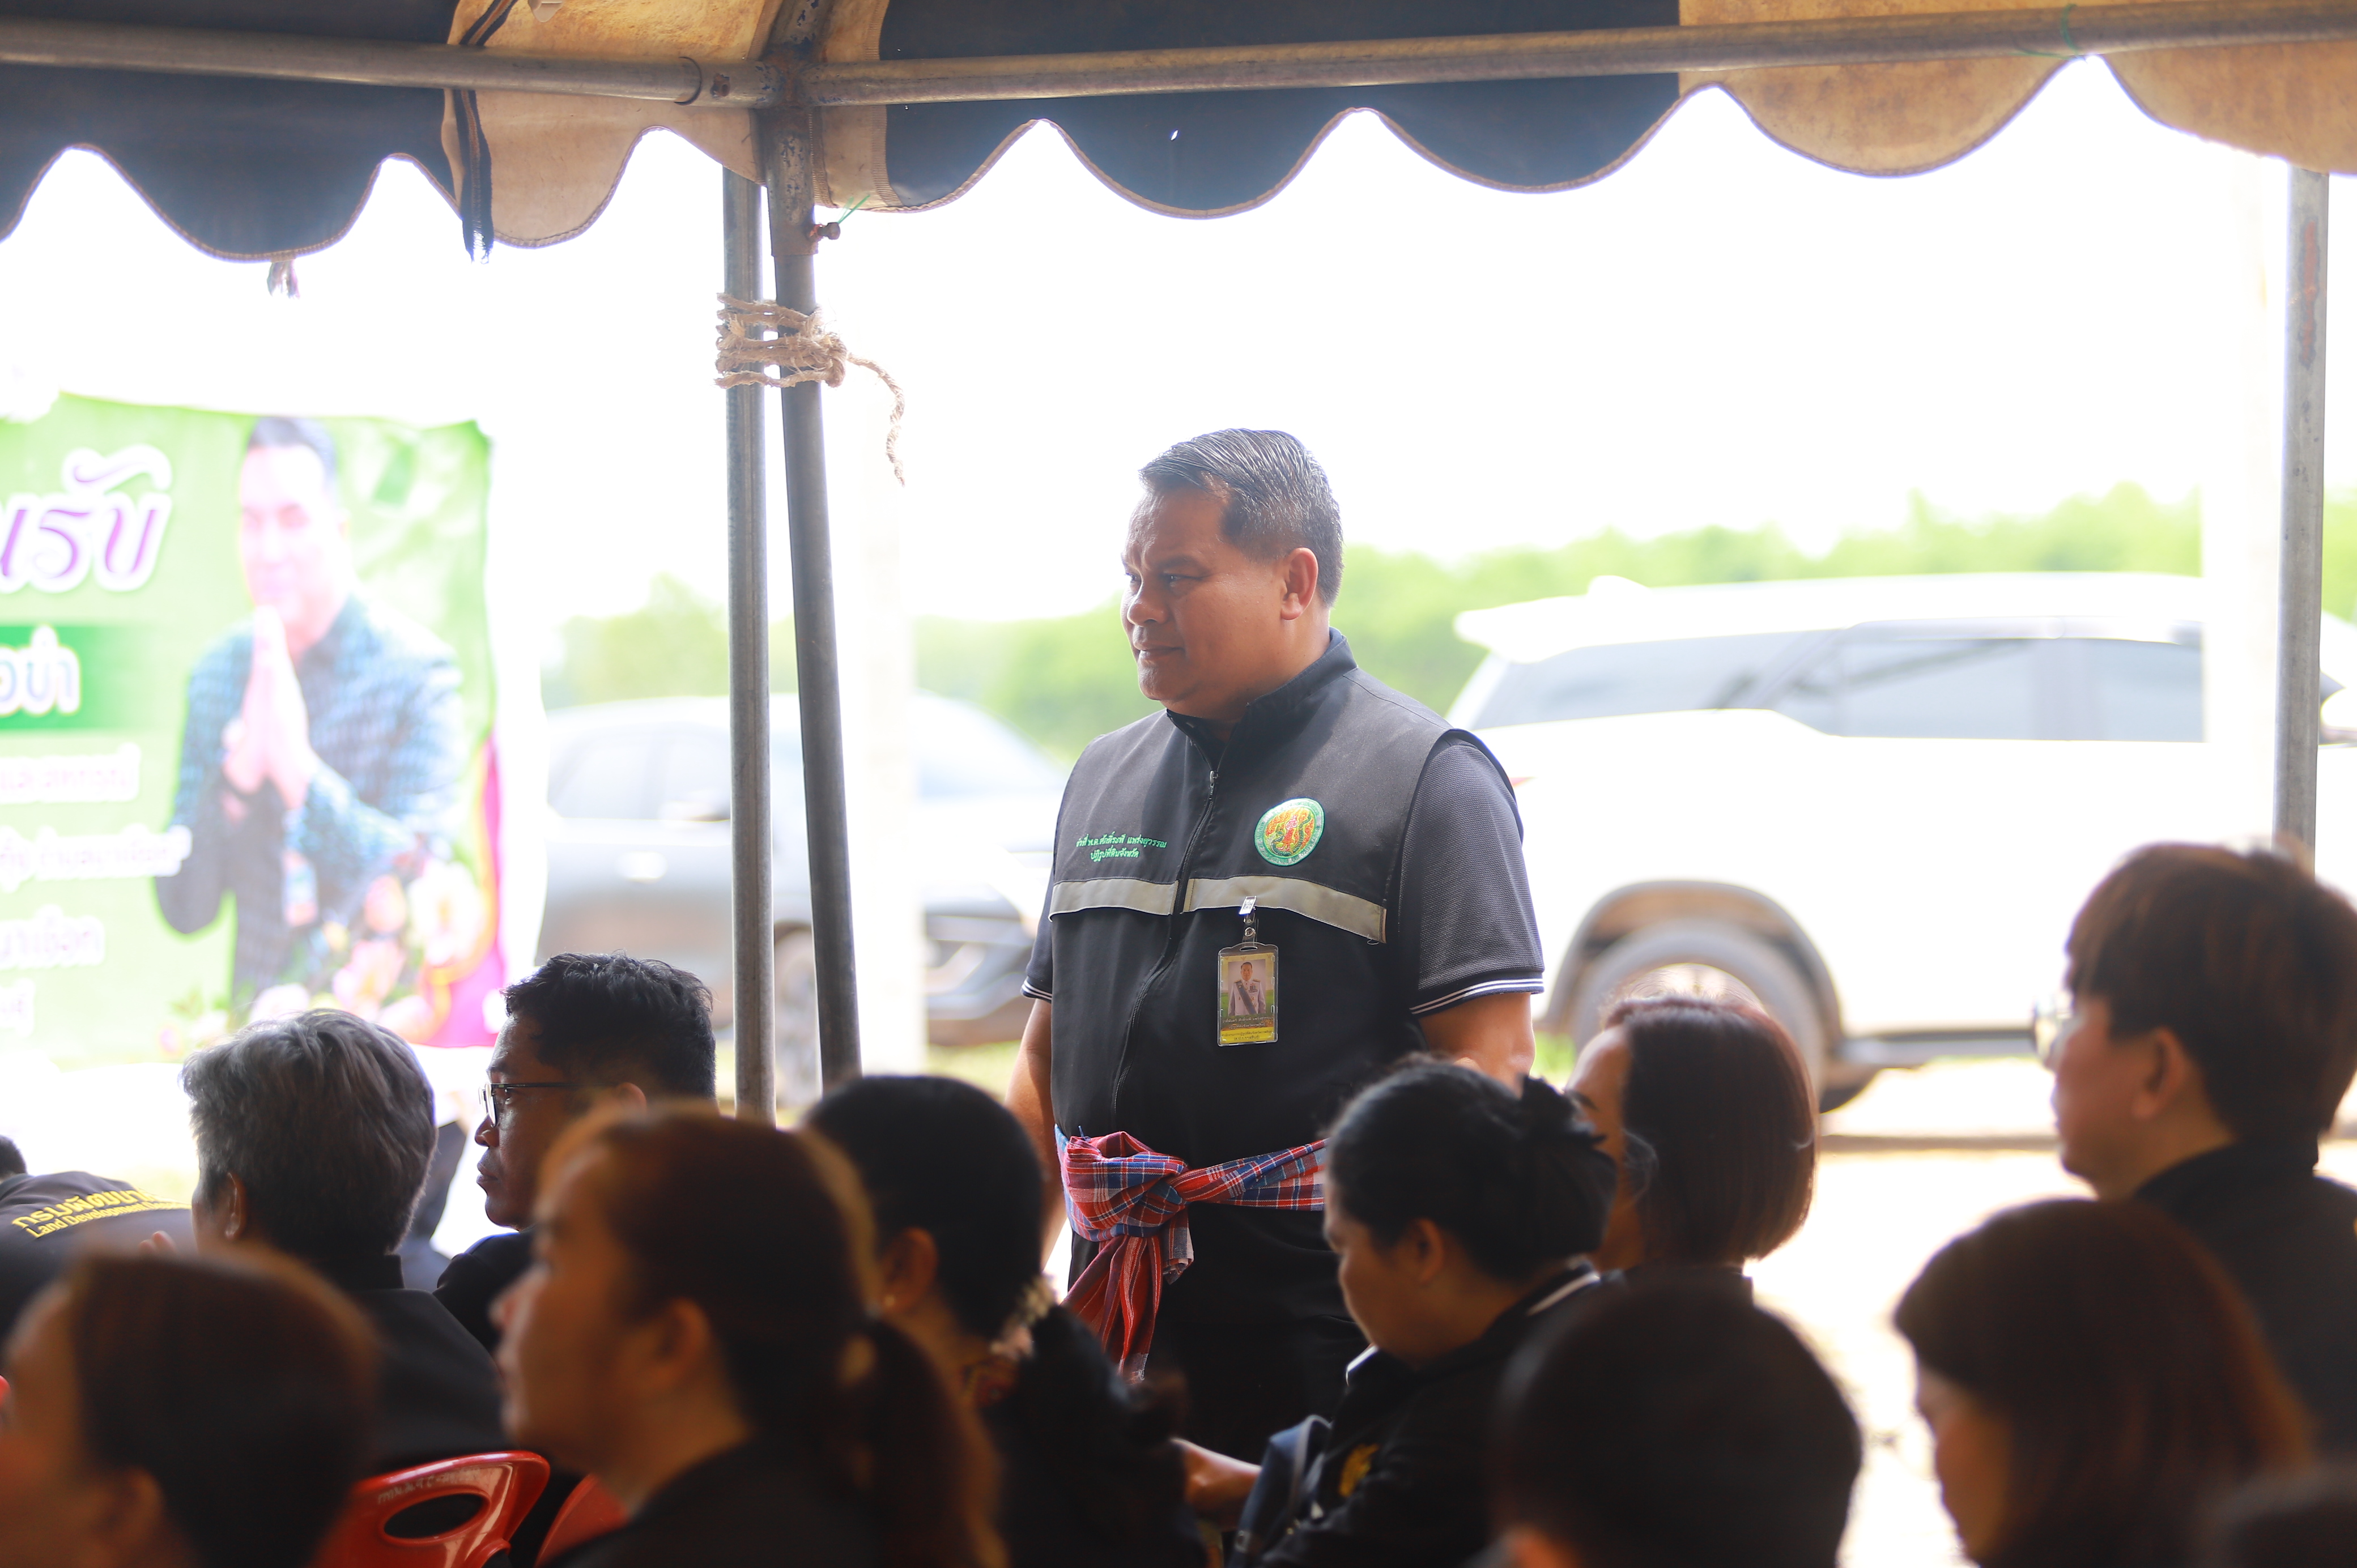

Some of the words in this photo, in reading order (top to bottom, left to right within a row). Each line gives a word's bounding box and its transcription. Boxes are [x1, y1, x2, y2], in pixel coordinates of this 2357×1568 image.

[1090, 845, 1139, 862] ปฏิรูปที่ดินจังหวัด
[11, 1189, 153, 1229] กรมพัฒนา
[27, 1218, 69, 1239] Land
[64, 1203, 147, 1227] Development
